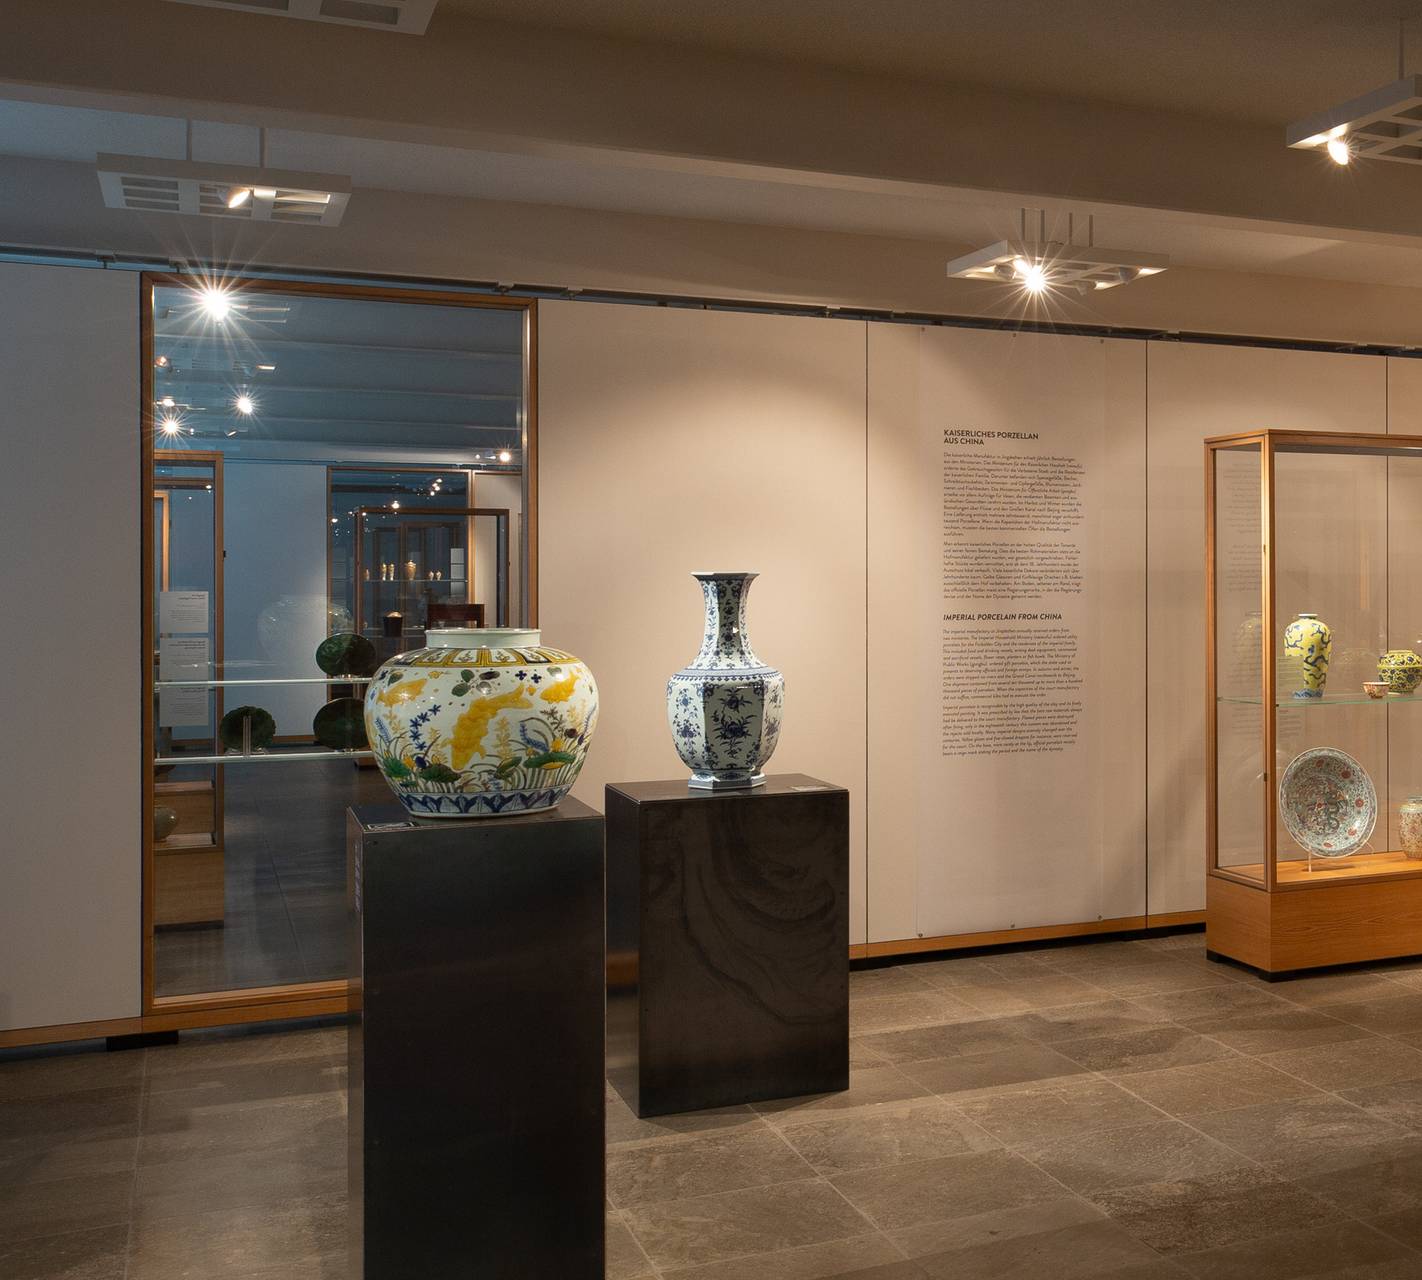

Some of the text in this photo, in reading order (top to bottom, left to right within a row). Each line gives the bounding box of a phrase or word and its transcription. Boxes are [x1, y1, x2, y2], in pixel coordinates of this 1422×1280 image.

[943, 429, 1039, 440] KAISERLICHES PORZELLAN
[960, 438, 985, 446] CHINA
